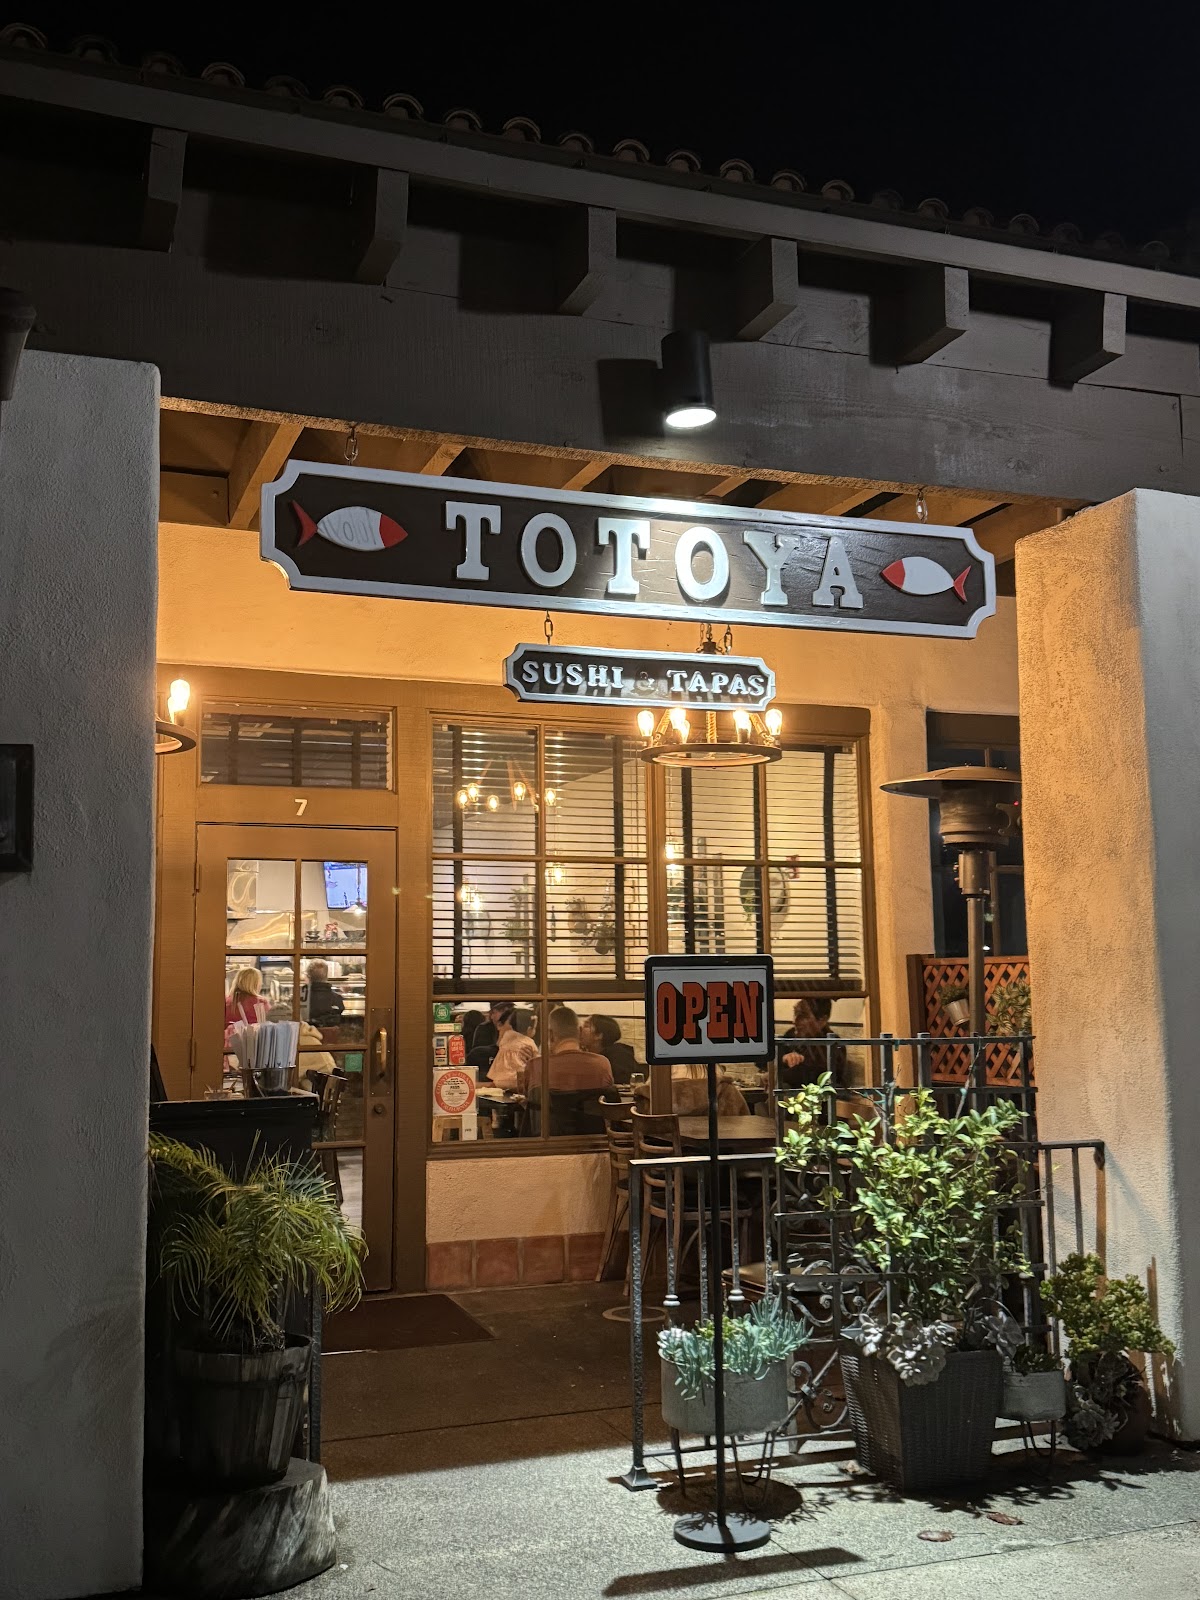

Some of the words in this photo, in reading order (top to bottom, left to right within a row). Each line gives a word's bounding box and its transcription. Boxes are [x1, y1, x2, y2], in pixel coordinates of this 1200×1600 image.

[445, 500, 864, 609] TOTOYA
[522, 660, 625, 690] SUSHI
[666, 669, 766, 697] TAPAS
[294, 798, 308, 816] 7
[656, 981, 765, 1046] OPEN
